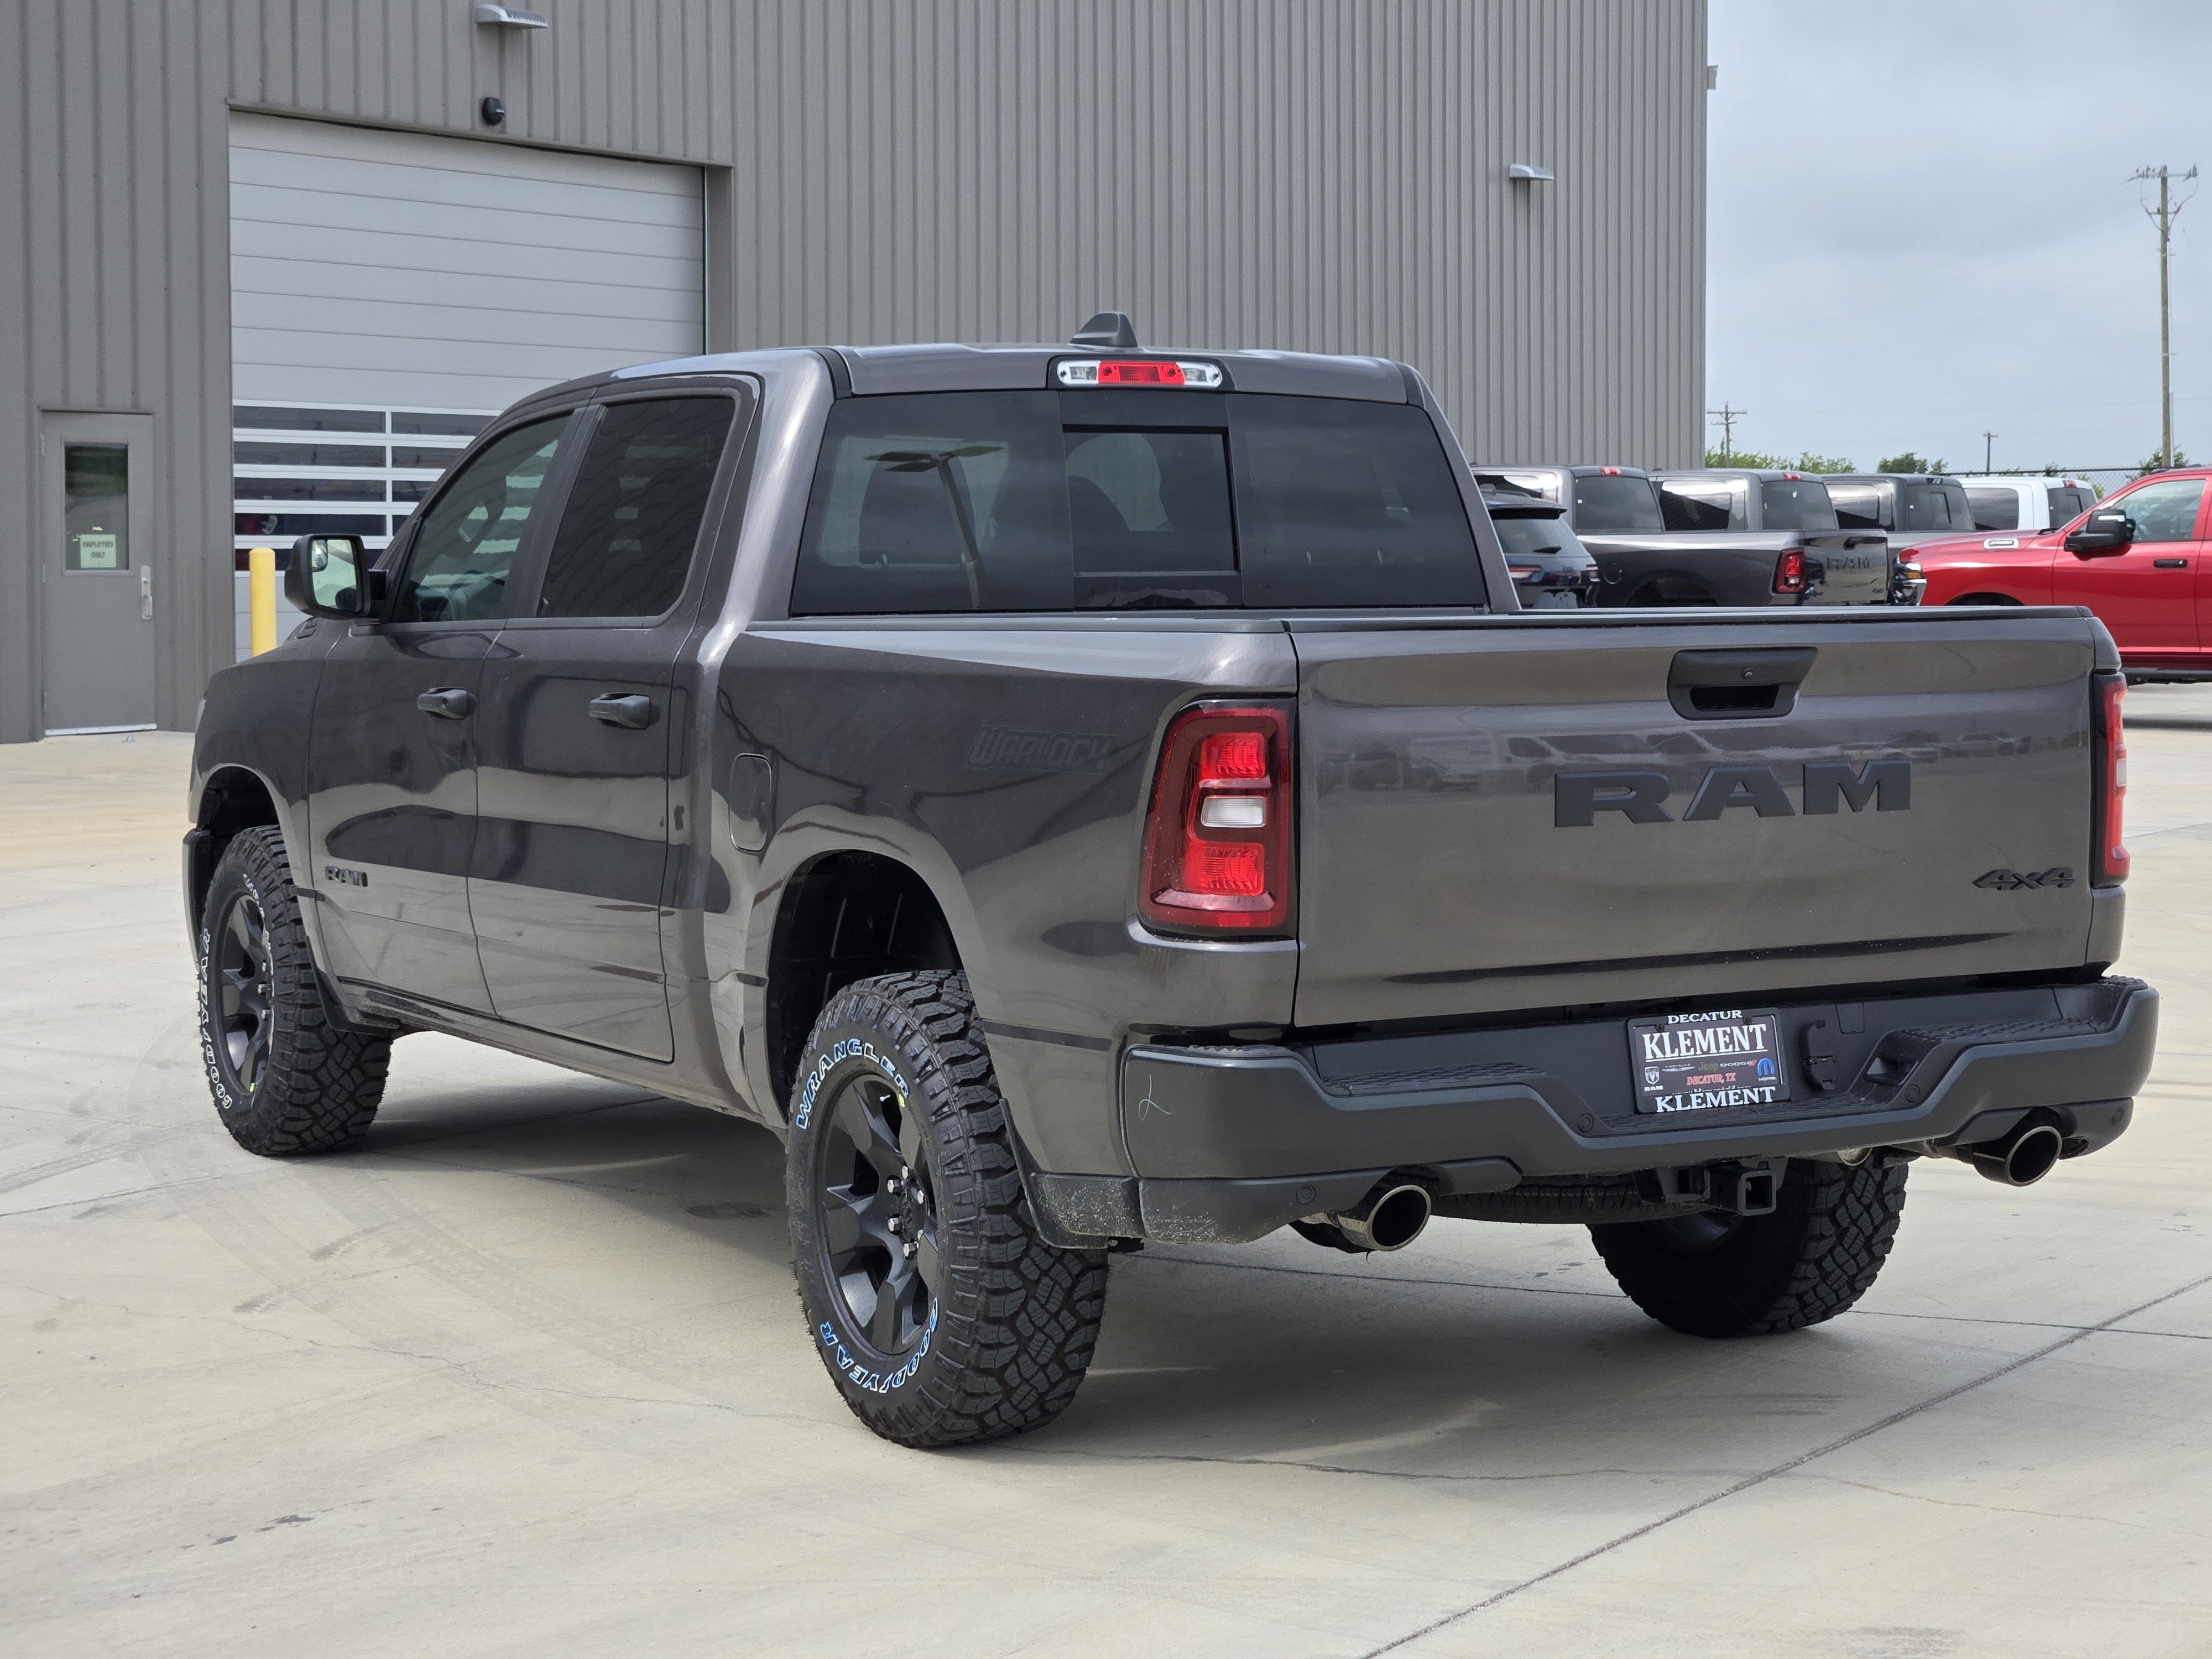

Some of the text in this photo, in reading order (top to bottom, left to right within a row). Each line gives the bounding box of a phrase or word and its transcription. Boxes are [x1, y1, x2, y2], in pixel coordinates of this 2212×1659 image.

[1827, 556, 1870, 570] RAM
[1554, 759, 1911, 828] RAM
[325, 865, 369, 887] RAM
[1667, 1010, 1743, 1024] DECATUR
[1642, 1024, 1767, 1060] KLEMENT
[1697, 1061, 1719, 1072] Jeep
[1725, 1072, 1736, 1082] TX
[796, 1038, 910, 1130] WRANGLER
[1655, 1087, 1776, 1113] KLEMENT
[820, 1297, 938, 1394] GOODYEAR
